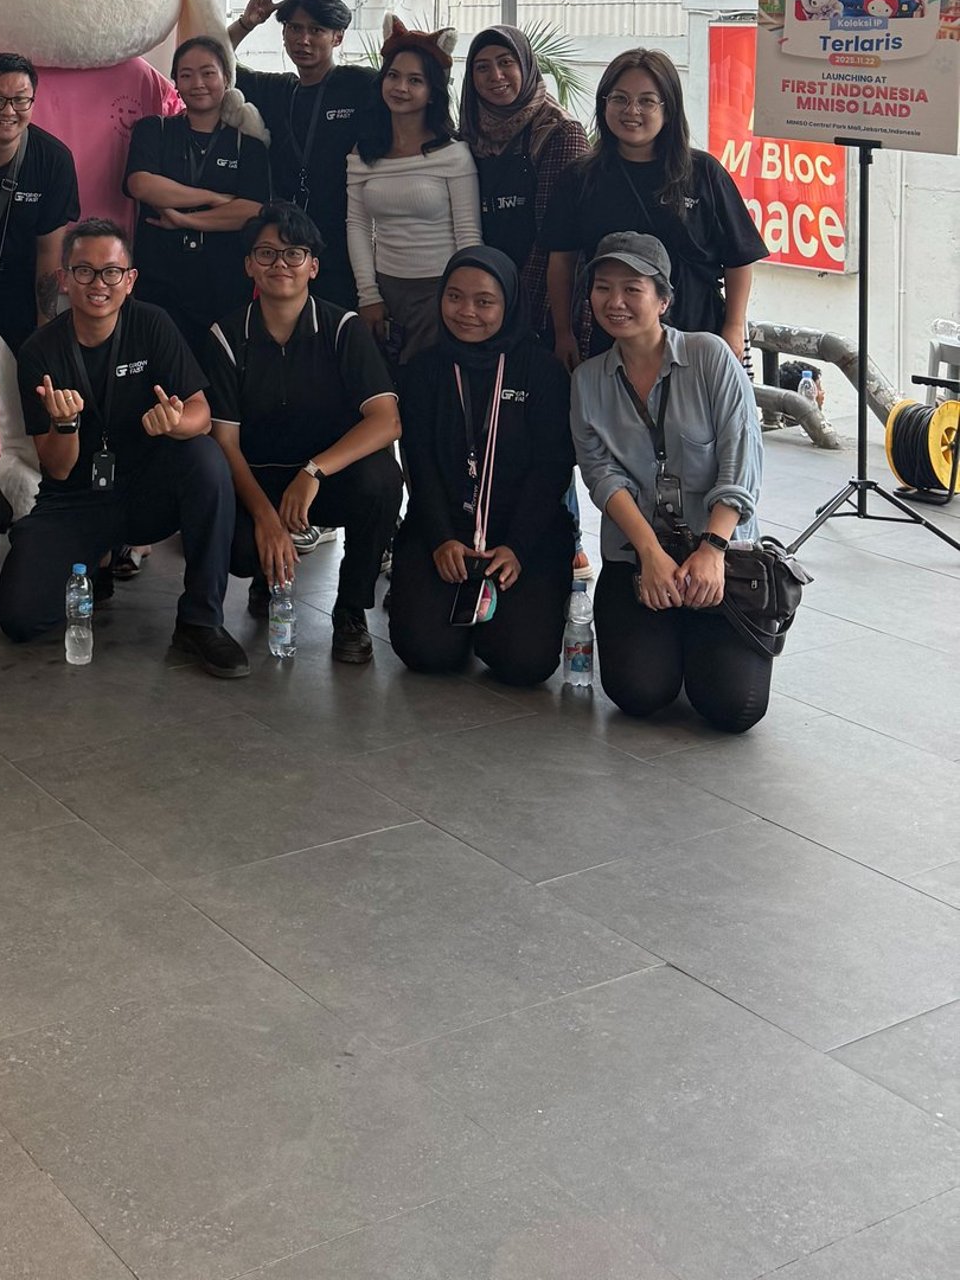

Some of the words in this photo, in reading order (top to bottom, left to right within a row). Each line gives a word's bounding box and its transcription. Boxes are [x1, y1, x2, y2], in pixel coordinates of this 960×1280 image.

[837, 19, 871, 27] Koleksi
[874, 19, 883, 27] IP
[819, 33, 903, 52] Terlaris
[822, 72, 873, 83] LAUNCHING
[875, 75, 887, 84] AT
[781, 79, 828, 95] FIRST
[831, 82, 929, 103] INDONESIA
[796, 96, 859, 114] MINISO
[863, 101, 911, 118] LAND
[786, 119, 807, 127] MINISO
[720, 139, 752, 177] M
[761, 142, 836, 186] Bloc
